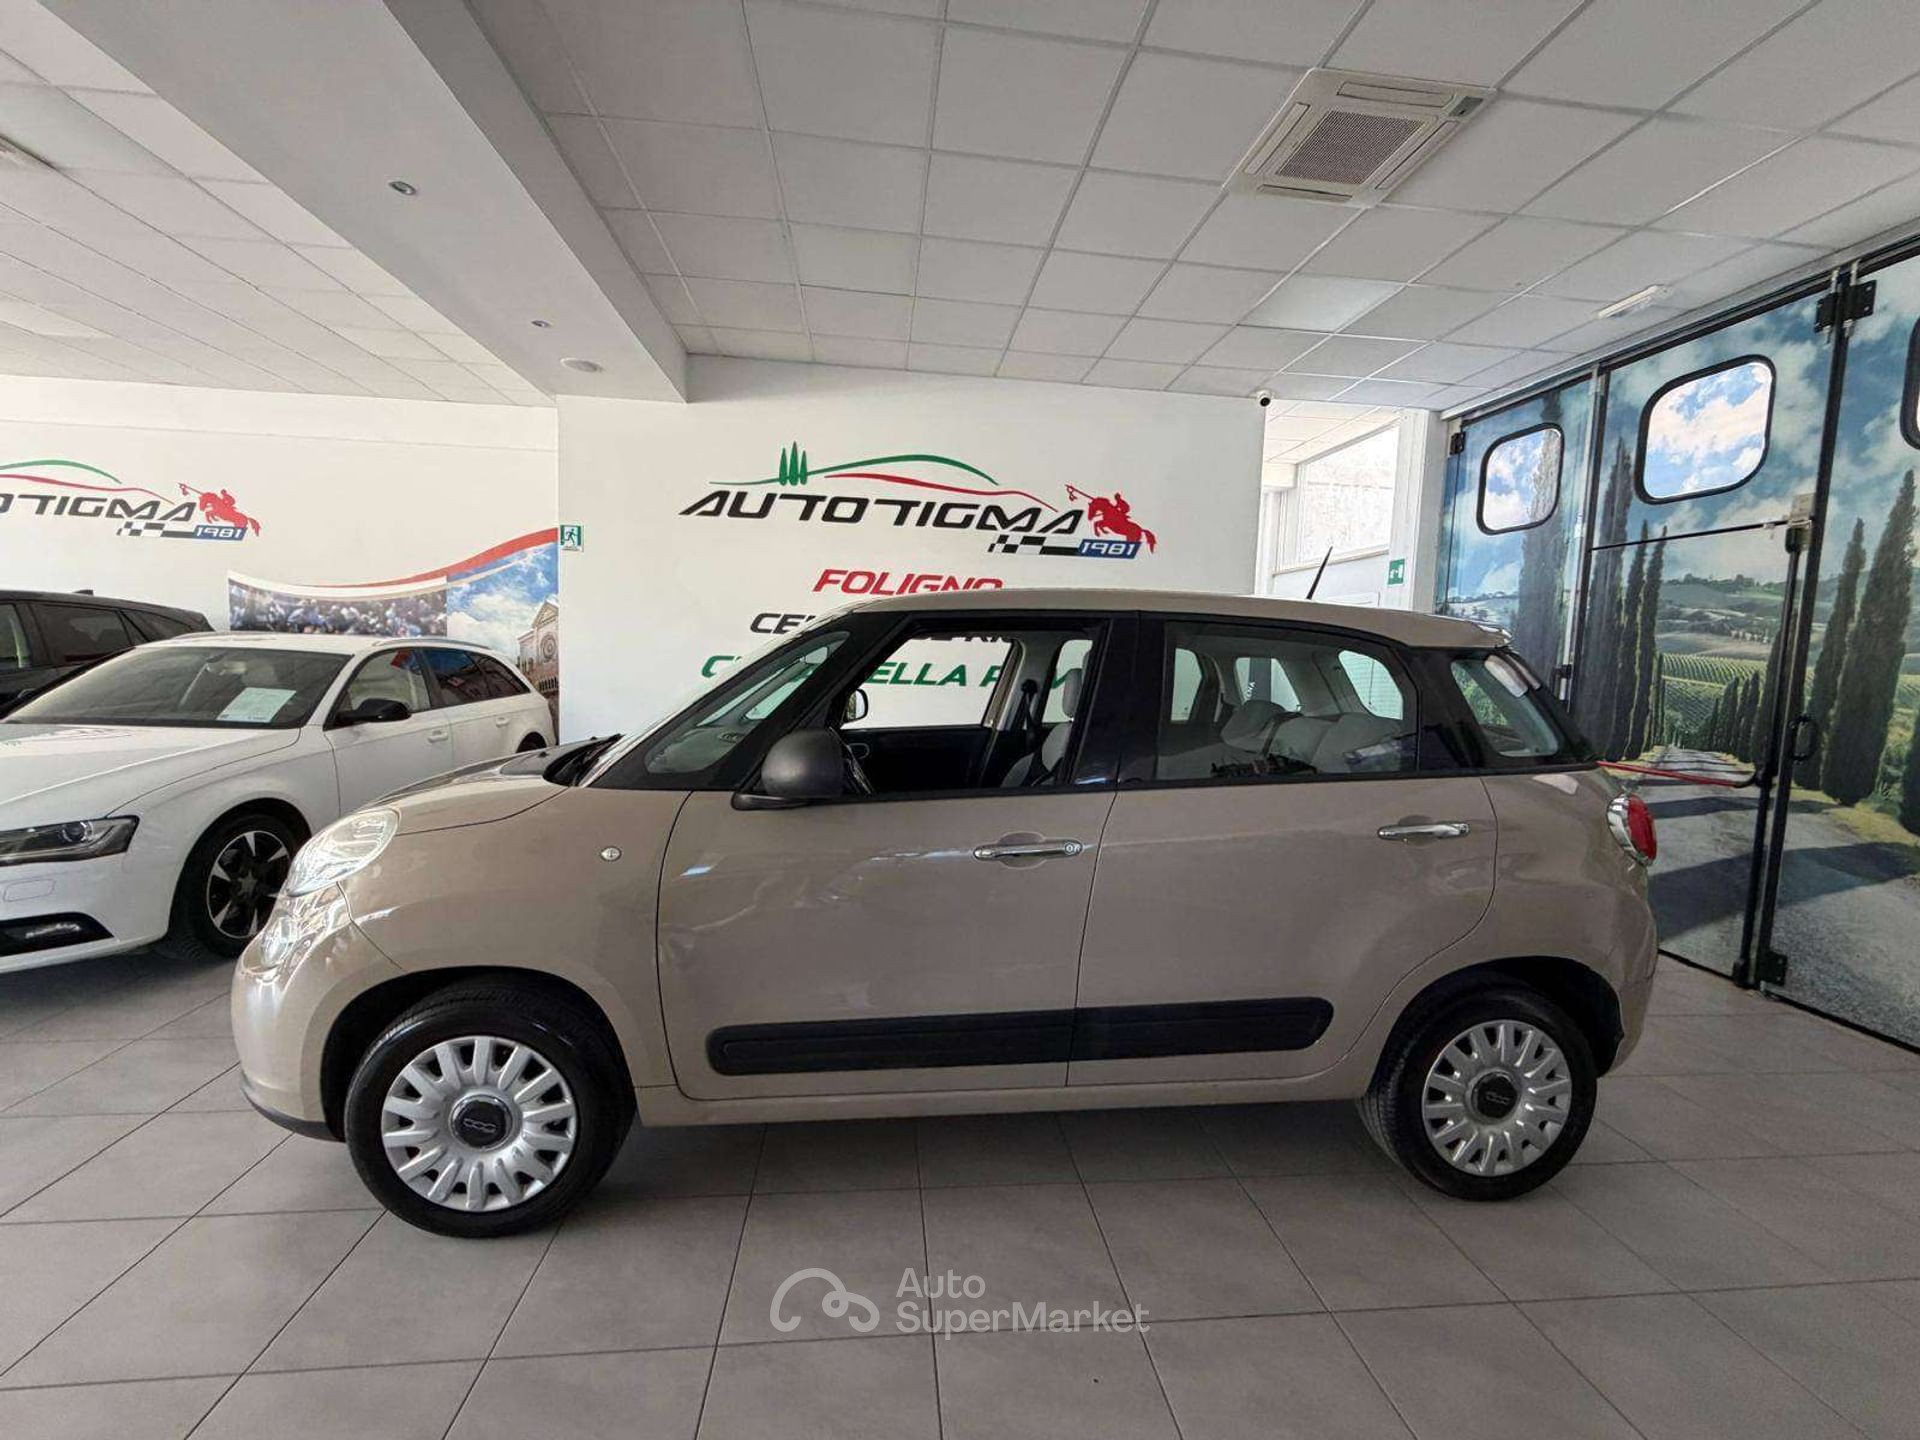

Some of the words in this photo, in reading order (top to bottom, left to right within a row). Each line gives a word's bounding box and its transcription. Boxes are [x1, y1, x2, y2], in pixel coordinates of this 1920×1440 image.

[679, 490, 1084, 534] AUTOTIGMA
[197, 526, 243, 540] 1981
[1081, 540, 1137, 556] 1981
